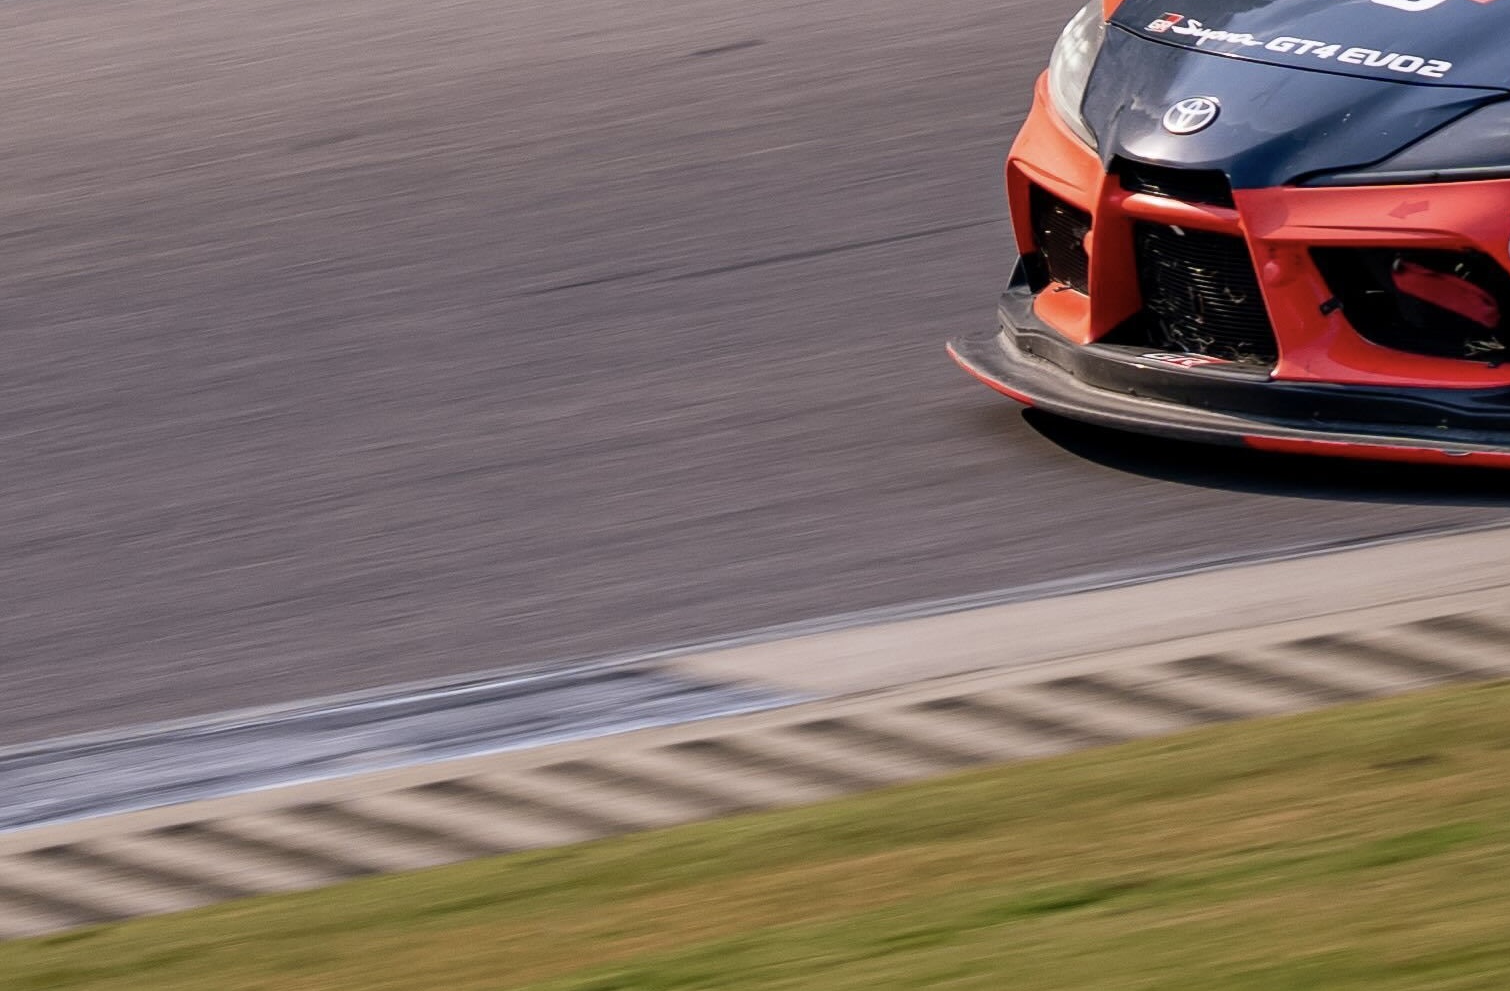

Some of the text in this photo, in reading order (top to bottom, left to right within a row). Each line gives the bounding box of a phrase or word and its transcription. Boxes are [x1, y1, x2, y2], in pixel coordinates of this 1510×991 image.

[1172, 19, 1264, 46] Supra
[1264, 36, 1342, 60] GT4
[1336, 47, 1453, 78] EVO2
